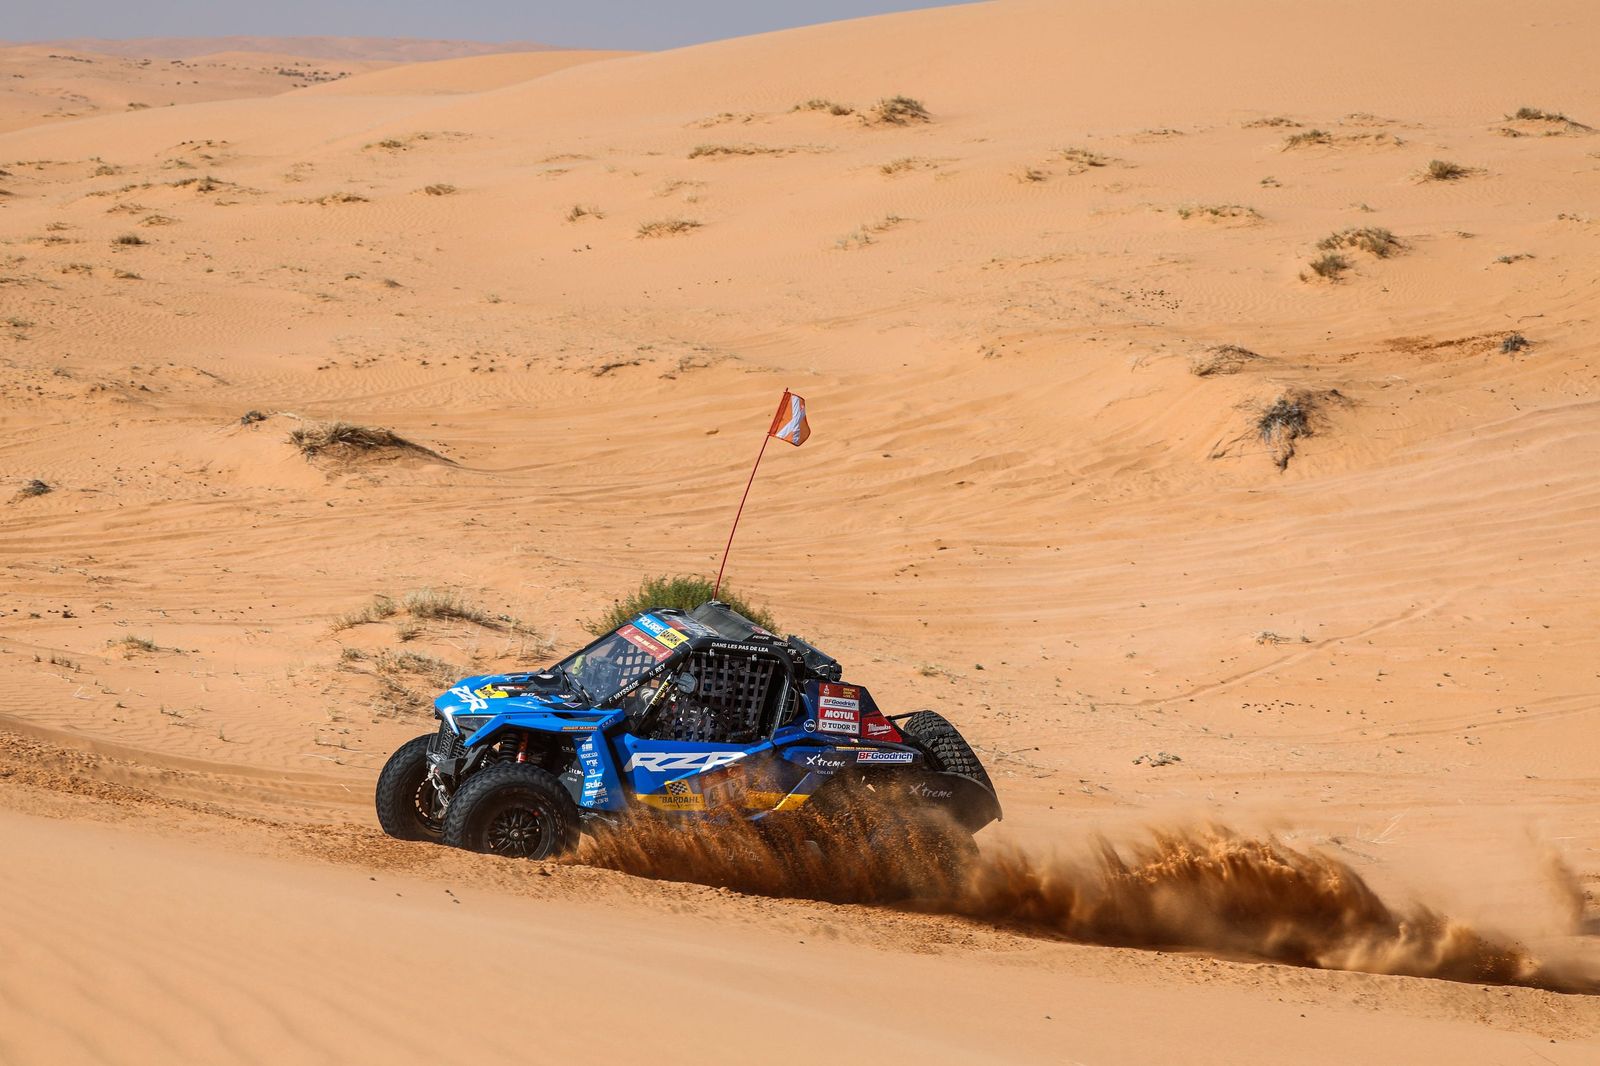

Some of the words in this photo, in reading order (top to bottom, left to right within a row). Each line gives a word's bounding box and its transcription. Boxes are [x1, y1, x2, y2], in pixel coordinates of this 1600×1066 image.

[655, 662, 666, 673] REY
[614, 679, 640, 700] VAYSSADE
[824, 699, 856, 707] BFGoodrich
[824, 710, 855, 720] MOTUL
[828, 722, 850, 730] TUDOR
[858, 752, 913, 761] BFGoodrich
